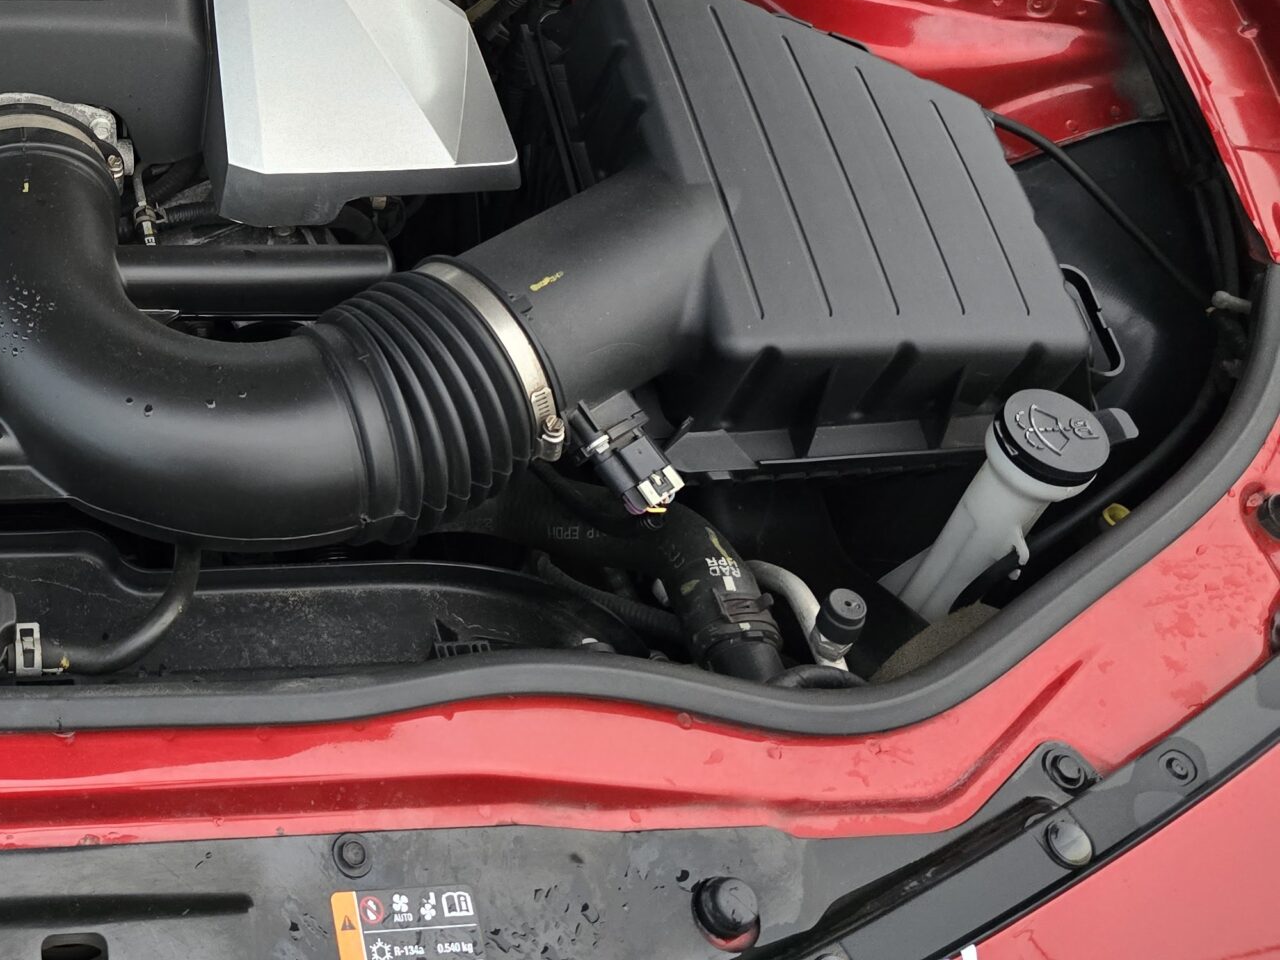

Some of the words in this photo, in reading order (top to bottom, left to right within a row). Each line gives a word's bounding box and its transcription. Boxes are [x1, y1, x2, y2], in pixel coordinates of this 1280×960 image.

[393, 912, 413, 923] AUTO
[437, 942, 462, 954] 0.540
[462, 941, 474, 954] kg
